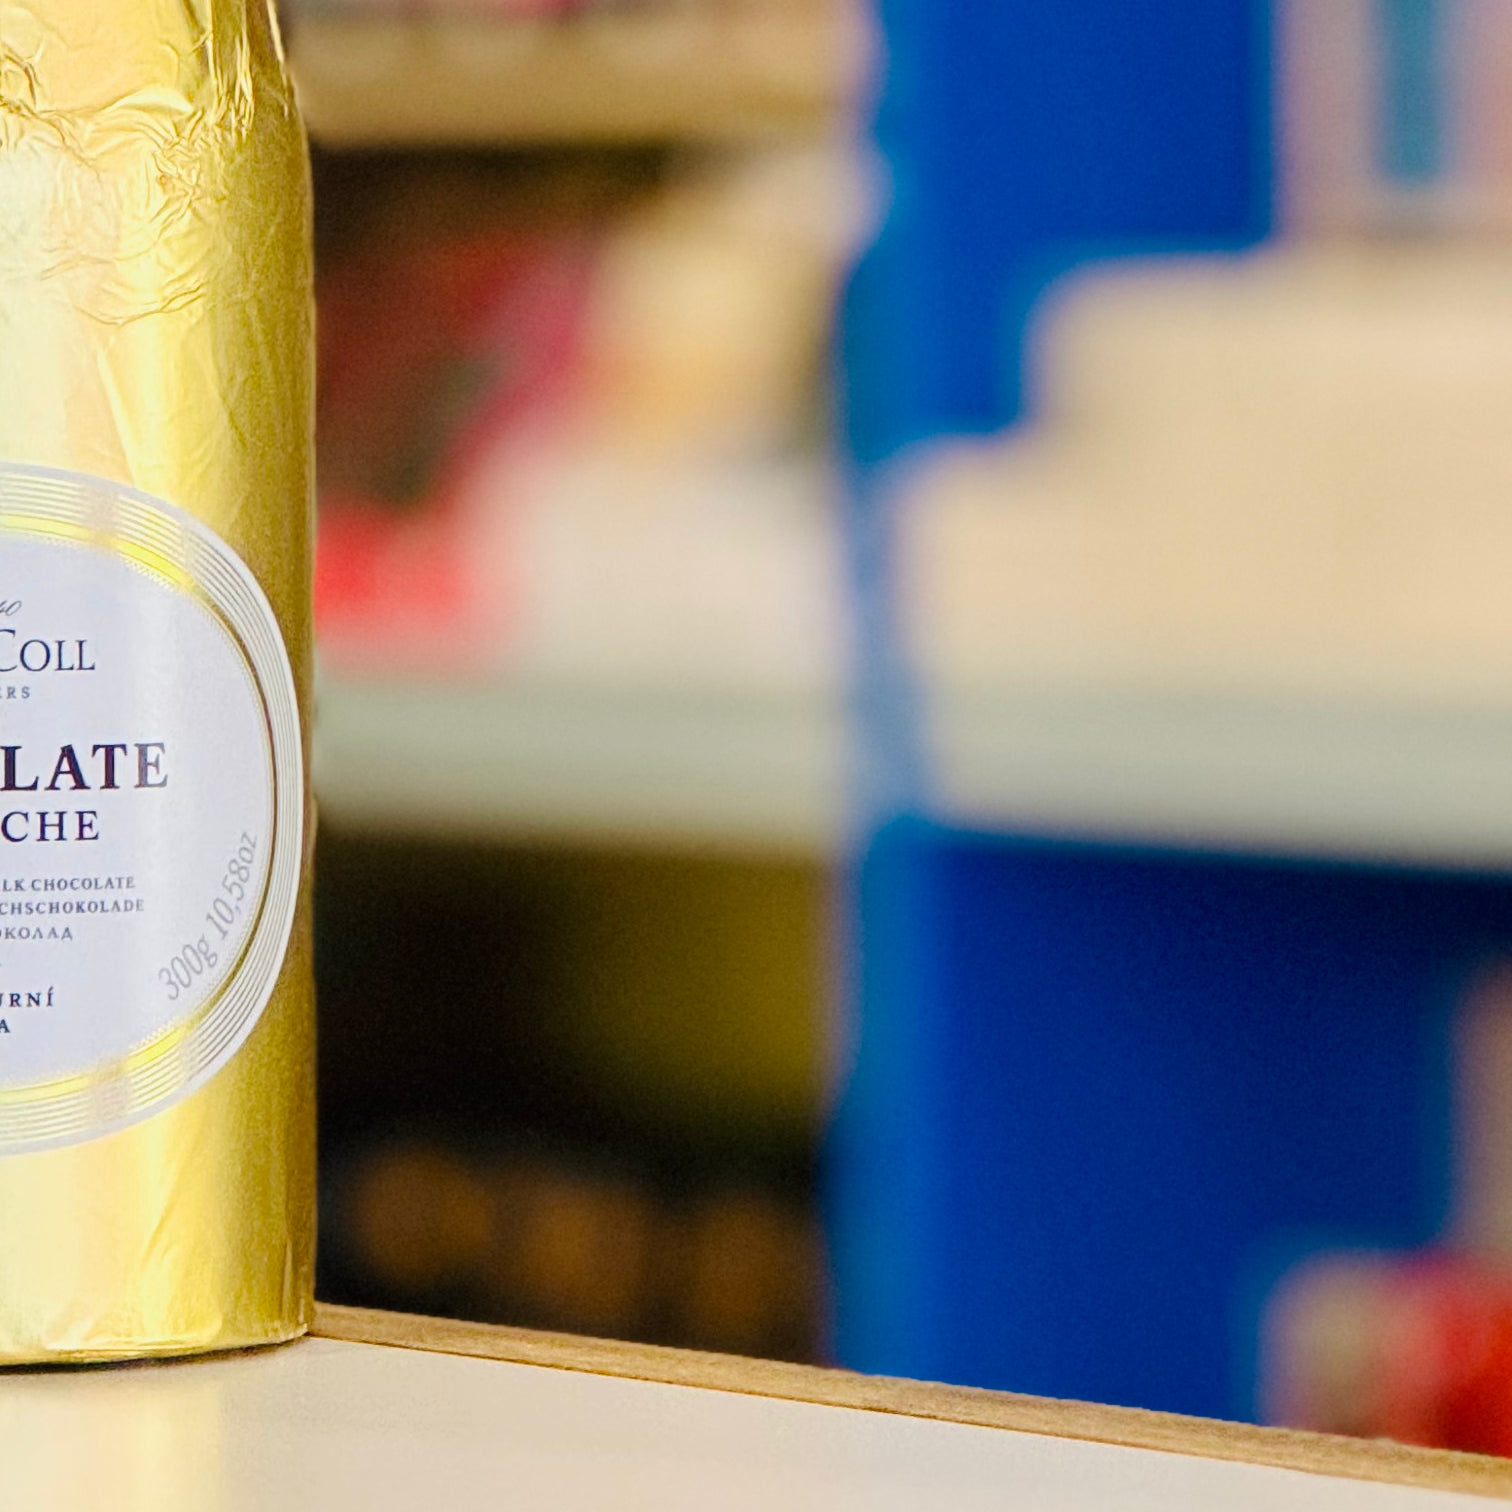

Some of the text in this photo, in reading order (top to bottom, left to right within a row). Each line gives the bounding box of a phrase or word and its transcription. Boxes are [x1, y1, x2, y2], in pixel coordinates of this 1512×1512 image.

[30, 875, 137, 892] CHOCOLATE
[157, 831, 257, 1001] 300g 10,58oz
